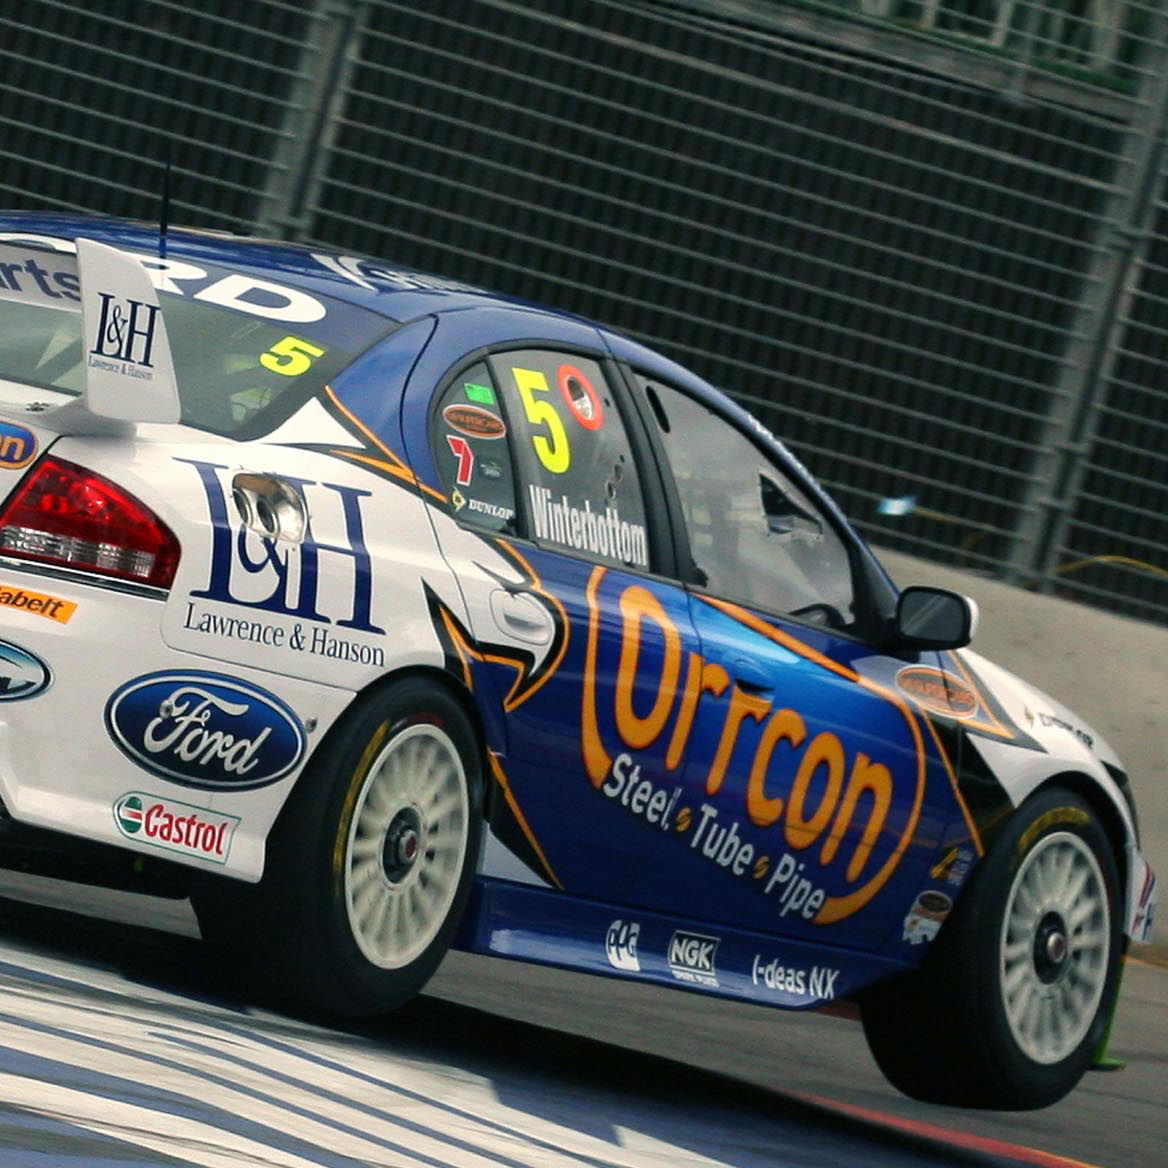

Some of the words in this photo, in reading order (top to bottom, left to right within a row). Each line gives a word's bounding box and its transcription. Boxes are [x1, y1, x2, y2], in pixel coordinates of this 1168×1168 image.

[90, 291, 161, 368] L&H
[260, 335, 325, 376] 5
[512, 367, 571, 474] 5
[469, 498, 515, 520] DUNLOP
[528, 484, 648, 566] Winterbottom
[183, 601, 284, 647] Lawrence
[289, 623, 306, 651] &
[310, 627, 385, 667] Hanson
[144, 686, 272, 776] Ford
[615, 585, 893, 883] Orrcon
[144, 803, 226, 855] Castrol
[603, 752, 678, 832] Steel
[689, 803, 755, 881] Tube
[765, 851, 826, 922] Pipe
[671, 937, 715, 970] NGK
[808, 965, 840, 1000] NX
